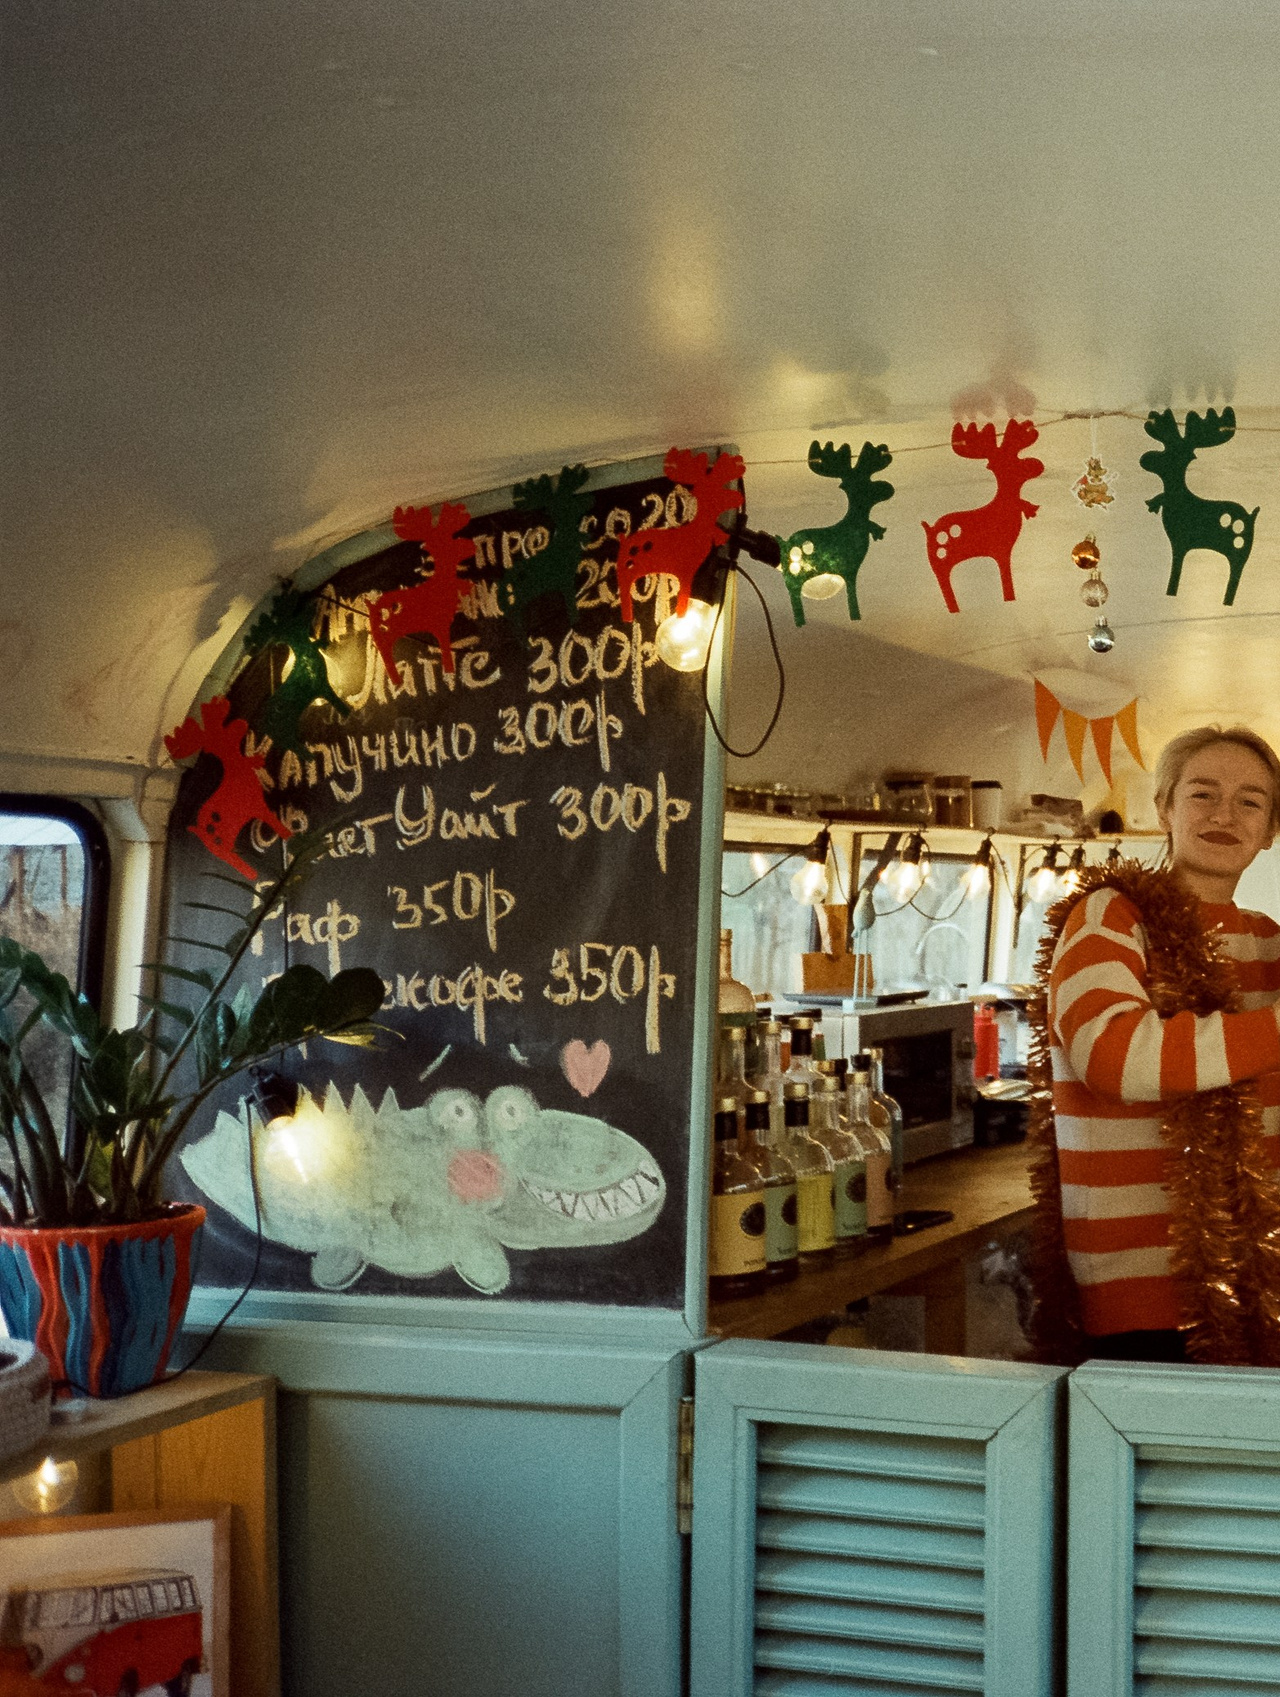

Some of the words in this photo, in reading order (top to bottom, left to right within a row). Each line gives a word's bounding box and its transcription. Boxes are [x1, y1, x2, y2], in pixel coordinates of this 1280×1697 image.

[549, 771, 693, 874] 300р
[386, 868, 516, 953] 350р
[542, 942, 677, 1055] 350р
